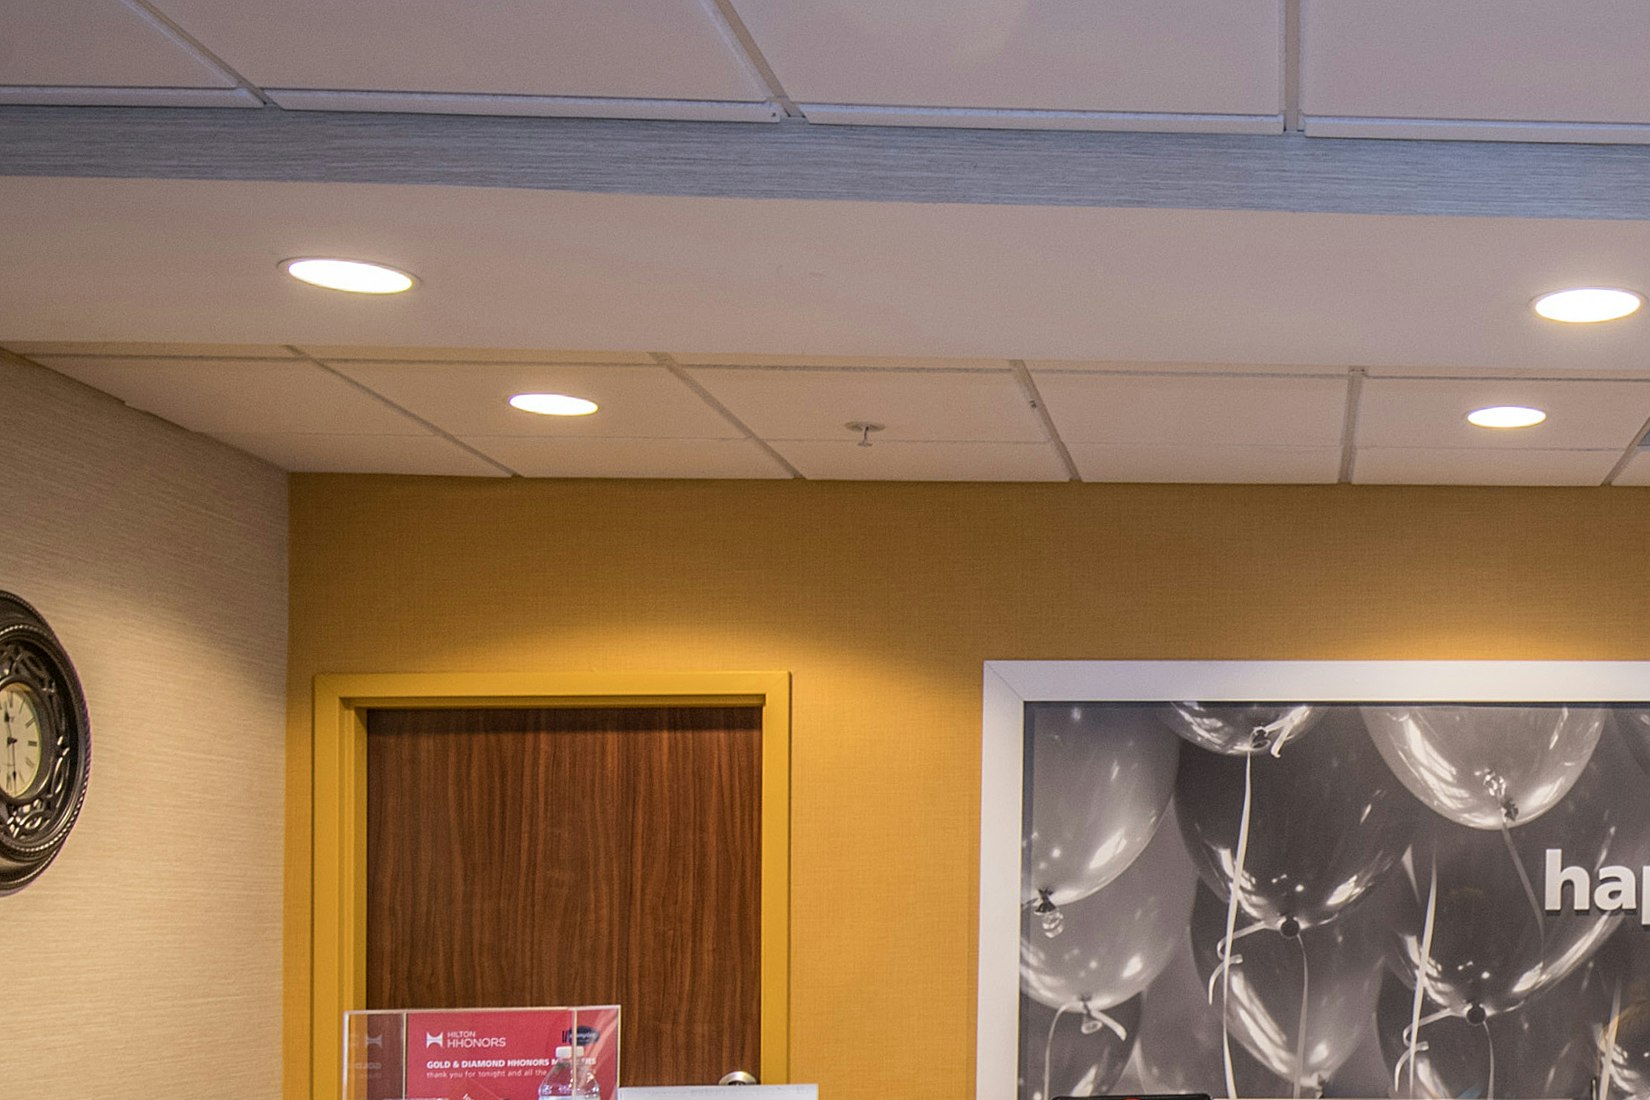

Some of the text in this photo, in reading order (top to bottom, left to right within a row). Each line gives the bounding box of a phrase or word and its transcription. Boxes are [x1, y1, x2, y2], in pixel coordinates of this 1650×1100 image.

[447, 1037, 506, 1048] HHONORS
[427, 1061, 450, 1069] GOLD
[453, 1061, 459, 1069] &
[461, 1059, 504, 1068] DIAMOND
[507, 1058, 549, 1067] HHONORS
[450, 1072, 463, 1080] you
[478, 1069, 506, 1079] tonight
